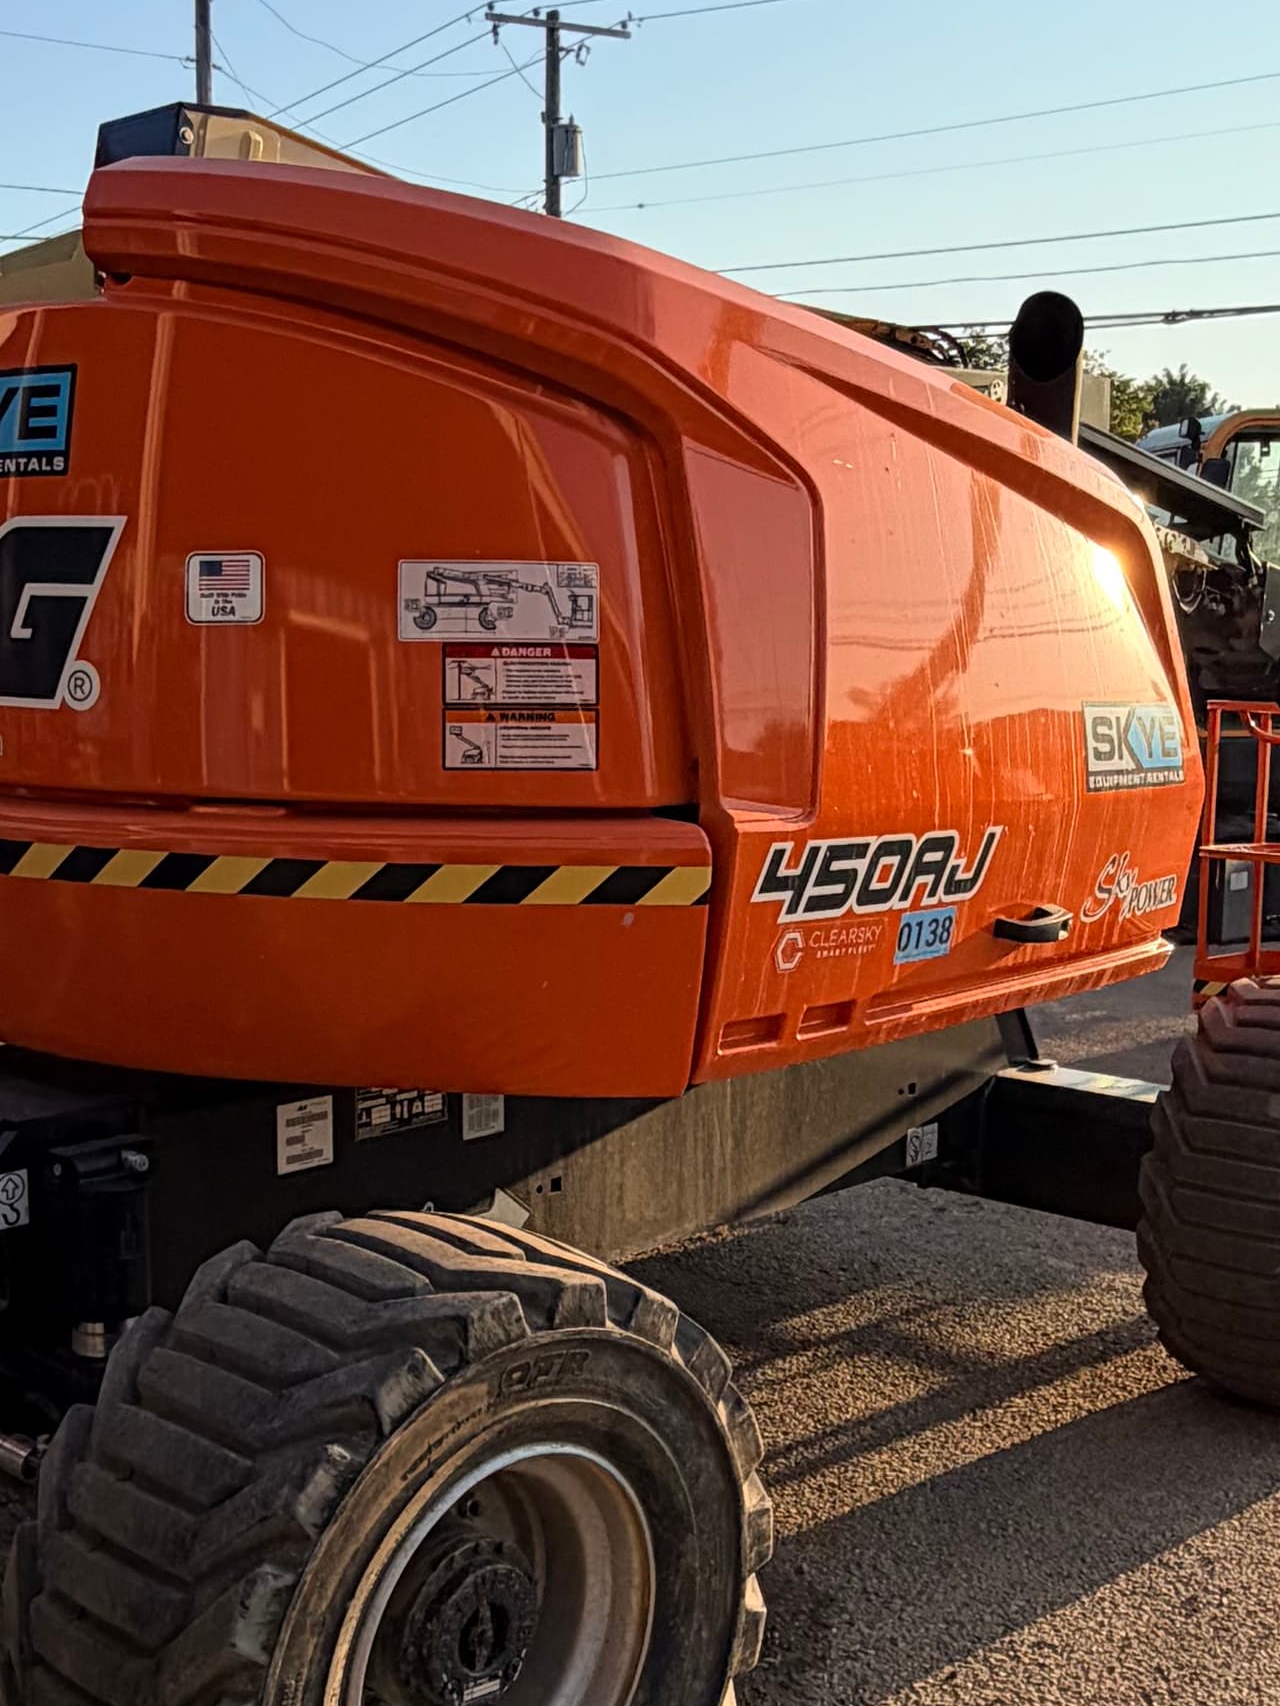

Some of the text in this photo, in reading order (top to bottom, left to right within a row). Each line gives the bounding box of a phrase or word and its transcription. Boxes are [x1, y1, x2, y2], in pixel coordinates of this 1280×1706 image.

[211, 605, 236, 617] USA
[501, 646, 552, 657] DANGER
[499, 713, 556, 722] WARNING
[1091, 715, 1179, 762] SKYE
[751, 825, 1004, 924] 450AJ
[809, 925, 883, 948] CLEARSKY
[897, 914, 954, 953] 0138
